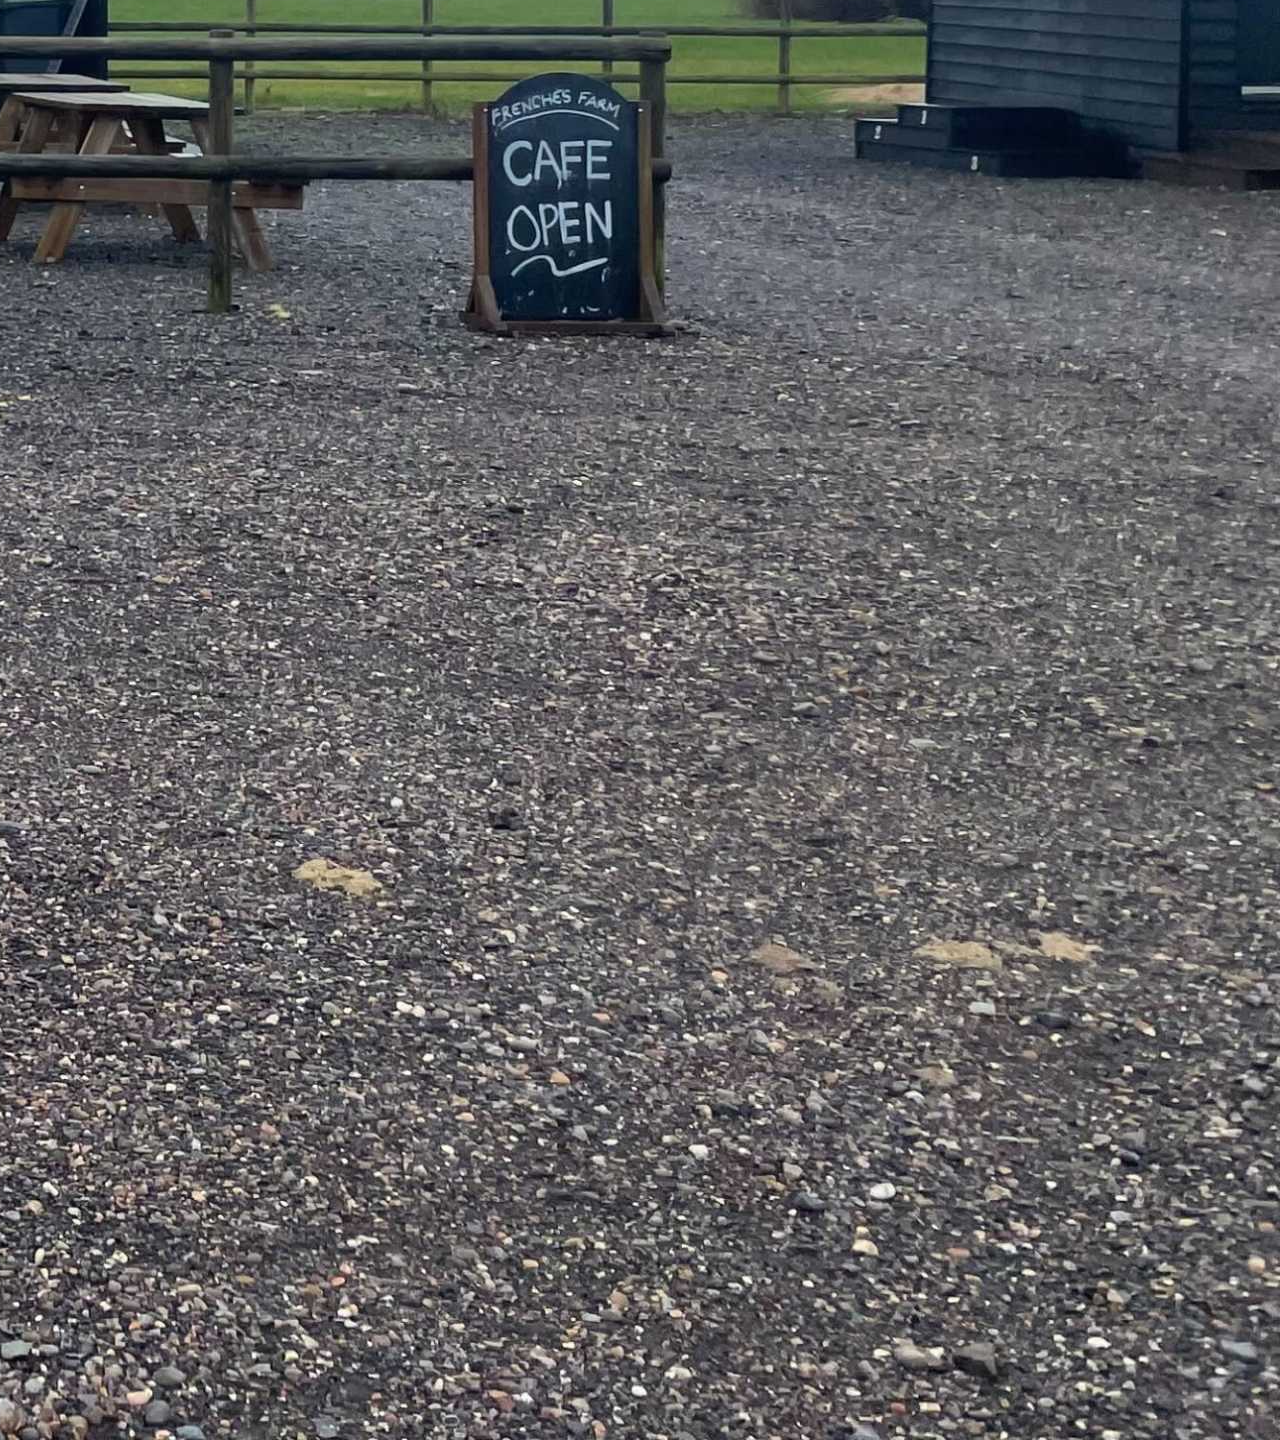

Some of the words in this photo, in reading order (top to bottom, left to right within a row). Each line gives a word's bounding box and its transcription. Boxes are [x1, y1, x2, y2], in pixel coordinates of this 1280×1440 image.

[491, 88, 572, 126] FRENCHES
[578, 91, 621, 118] FARM
[503, 140, 613, 189] CAFE
[507, 200, 613, 251] OPEN
